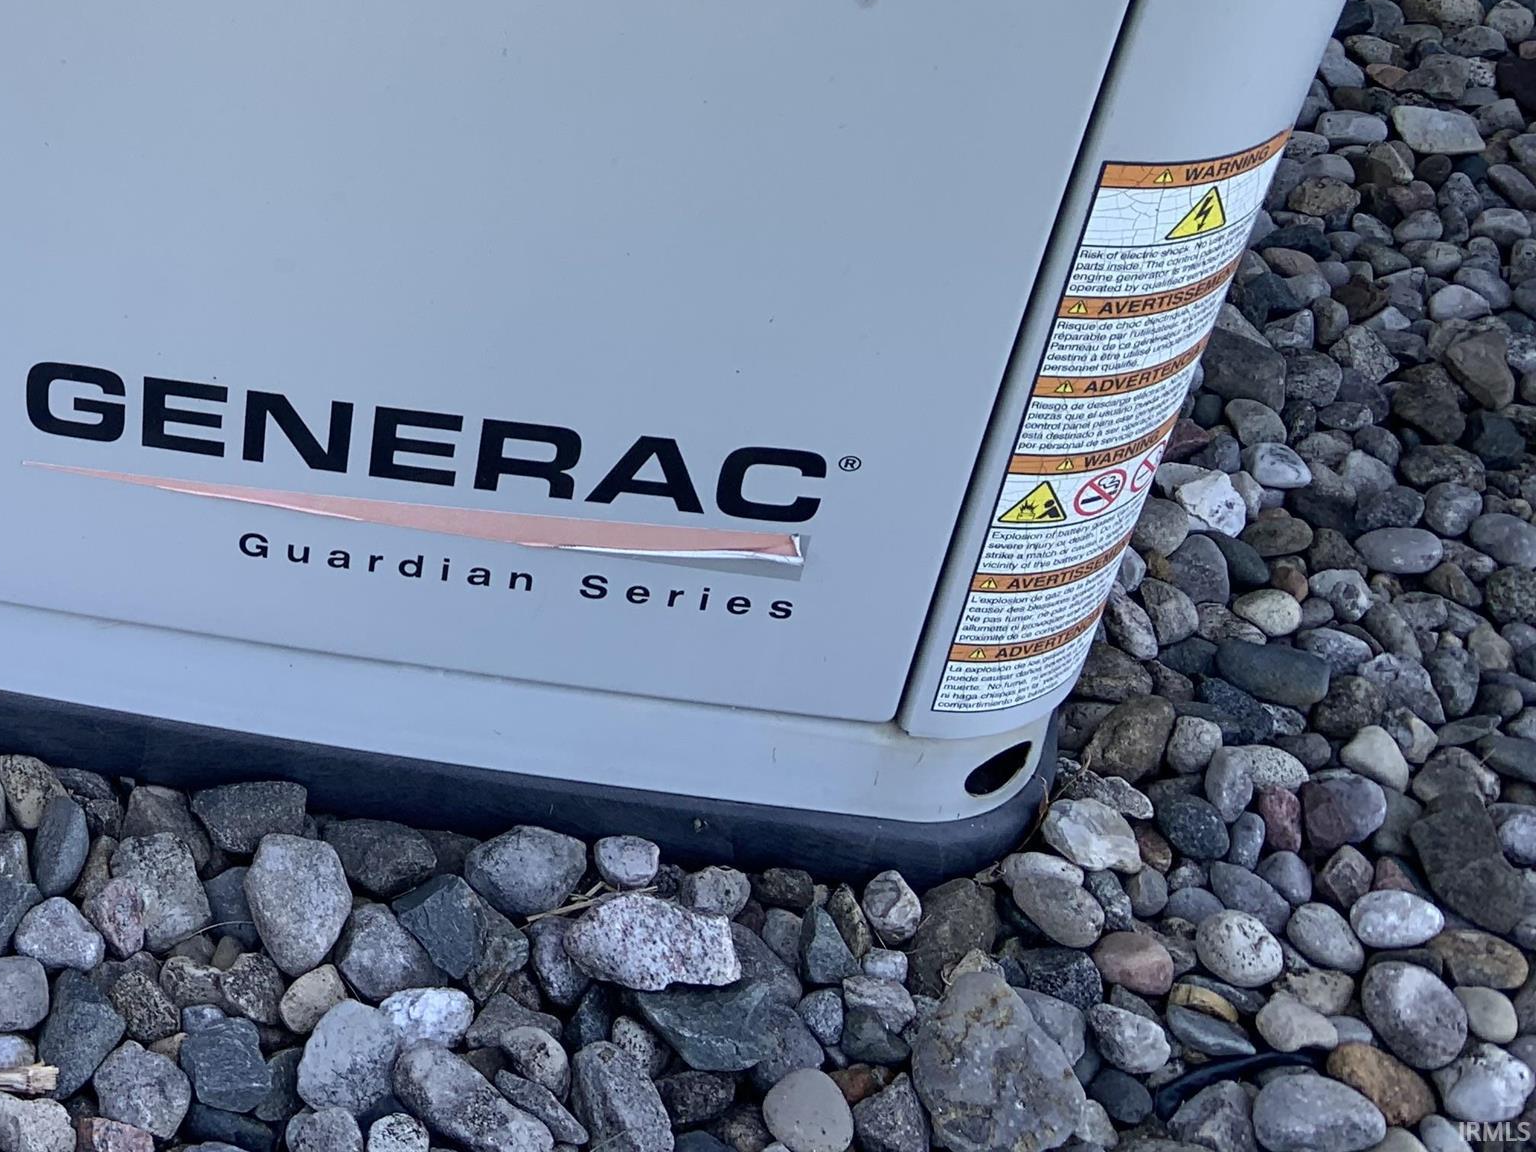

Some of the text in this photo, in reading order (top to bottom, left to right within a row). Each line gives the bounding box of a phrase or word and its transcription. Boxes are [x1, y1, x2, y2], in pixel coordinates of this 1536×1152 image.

[1185, 146, 1270, 181] WARNING
[1080, 250, 1103, 259] Risk
[1106, 251, 1119, 259] of
[1120, 250, 1158, 259] electric
[1076, 261, 1104, 271] parts
[1146, 260, 1164, 268] The
[1073, 272, 1113, 283] engine
[1116, 269, 1169, 283] generator
[1069, 284, 1121, 293] operated
[1124, 284, 1139, 293] by
[1098, 260, 1236, 315] AVERTISSEMEN
[1057, 320, 1096, 331] Risque
[1099, 322, 1113, 330] de
[1116, 320, 1142, 329] choc
[1109, 332, 1127, 344] par
[1050, 342, 1099, 352] Panneau
[1043, 364, 1098, 372] personnel
[1032, 401, 1067, 411] Riesgo
[1071, 402, 1084, 410] de
[1028, 412, 1062, 420] piezas
[1065, 413, 1084, 421] que
[1025, 422, 1061, 430] control
[1063, 422, 1090, 431] panel
[1046, 430, 1094, 440] destinado
[25, 360, 829, 524] GENERAC
[1018, 442, 1037, 450] por
[1039, 441, 1084, 451] personal
[1086, 439, 1099, 447] de
[1084, 430, 1161, 468] WARNING
[992, 531, 1042, 541] Explosion
[1046, 529, 1057, 539] of
[1026, 541, 1053, 551] injury
[1026, 550, 1057, 559] match
[983, 561, 1018, 570] vicinity
[1007, 536, 1128, 589] AVERTISSEMEN
[238, 530, 797, 621] Guardian Series
[952, 692, 978, 700] haga
